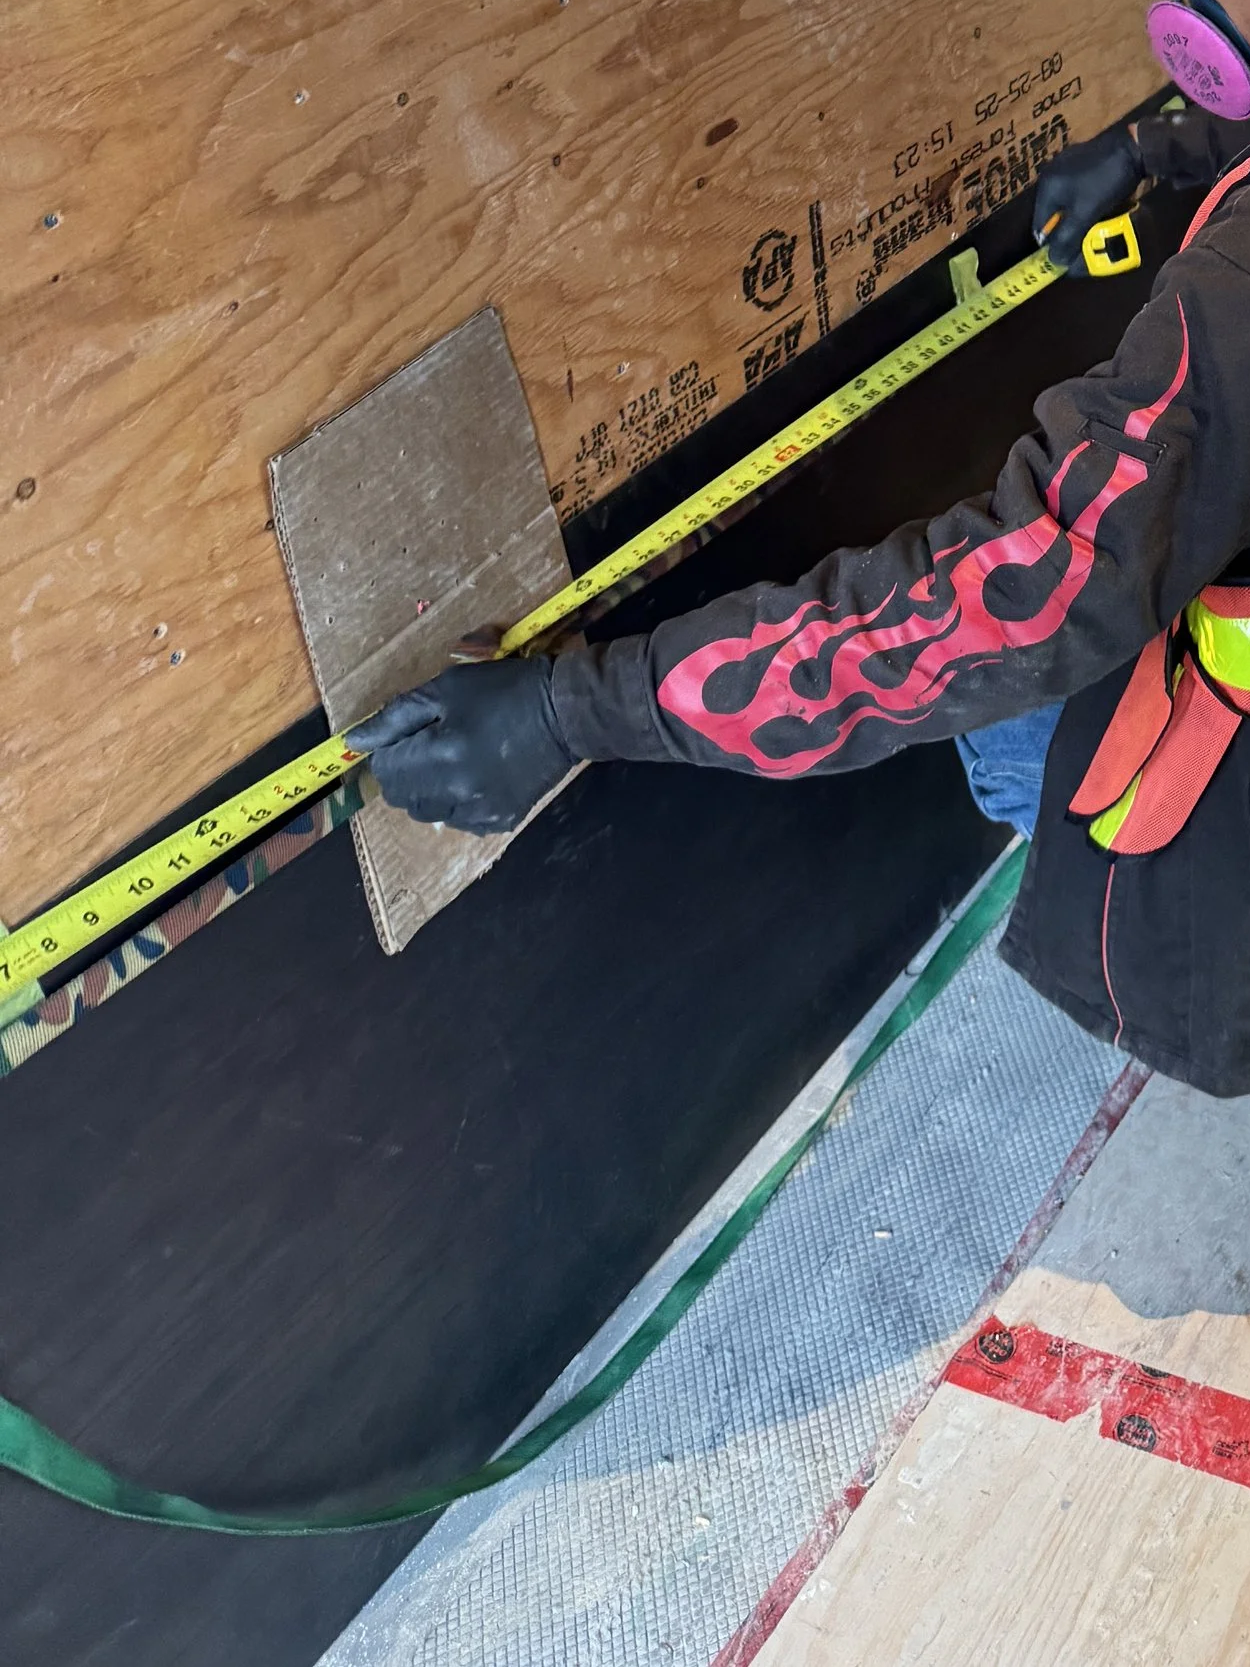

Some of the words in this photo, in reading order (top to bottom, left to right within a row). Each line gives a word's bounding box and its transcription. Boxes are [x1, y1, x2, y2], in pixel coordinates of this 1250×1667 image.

[975, 51, 1064, 125] 08-25-25
[1031, 76, 1083, 119] Canoe
[892, 120, 955, 178] 15:23
[950, 119, 1016, 172] Forest
[963, 113, 1071, 229] CANOE
[829, 176, 932, 258] Products
[743, 310, 809, 392] APA
[40, 936, 59, 954] 8
[82, 910, 100, 927] 9
[127, 877, 155, 897] 10
[167, 852, 192, 872] 11
[209, 830, 238, 850] 12
[246, 807, 273, 825] 13
[282, 784, 308, 802] 14
[317, 762, 342, 780] 15
[711, 495, 733, 509] 29
[734, 479, 755, 492] 30
[758, 464, 776, 476] 31
[801, 432, 821, 445] 33
[822, 417, 842, 430] 34
[842, 402, 861, 416] 35
[862, 388, 881, 401] 36
[882, 374, 900, 387] 37
[900, 360, 919, 374] 38
[919, 347, 937, 361] 39
[938, 335, 955, 348] 40
[956, 322, 973, 335] 41
[973, 309, 990, 322] 42
[990, 297, 1006, 310] 43
[1006, 285, 1023, 298] 44
[1023, 274, 1039, 286] 45
[273, 784, 285, 796] 2
[307, 764, 318, 773] 3
